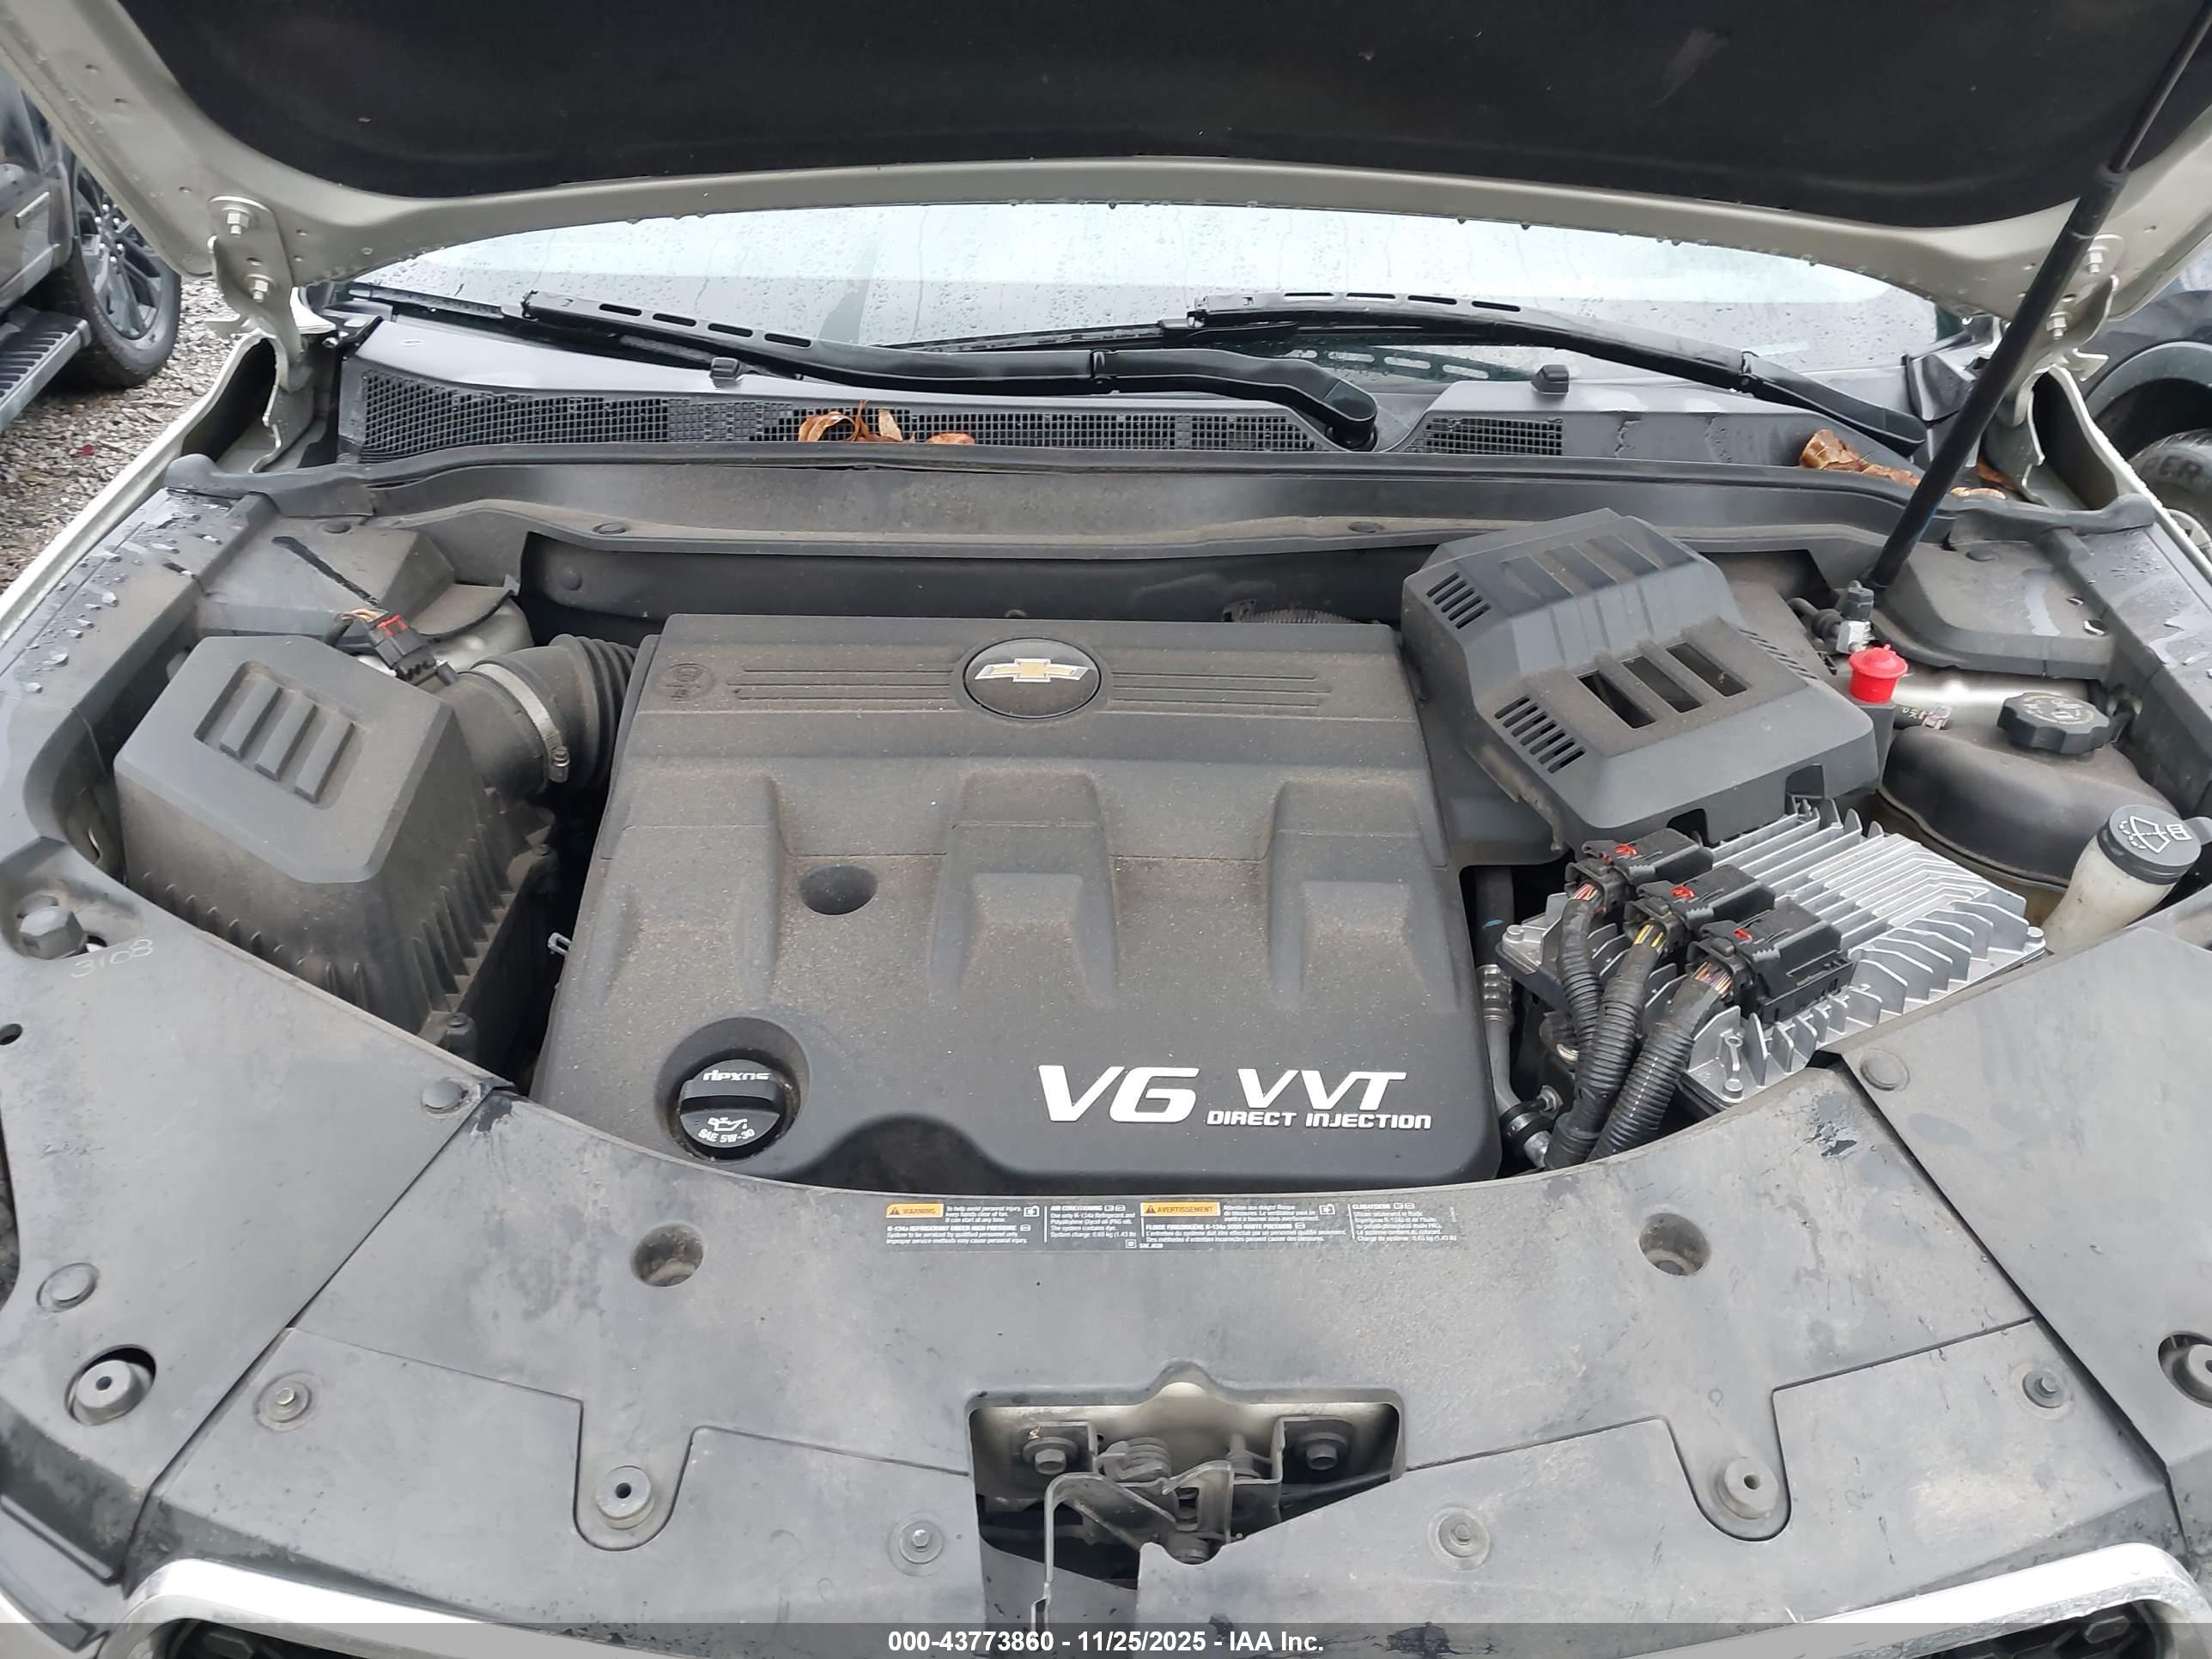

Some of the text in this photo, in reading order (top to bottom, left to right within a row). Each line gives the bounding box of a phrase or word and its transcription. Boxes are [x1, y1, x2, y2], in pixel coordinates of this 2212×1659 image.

[1038, 1065, 1200, 1122] V6
[1237, 1068, 1407, 1110] VVT
[1206, 1110, 1431, 1129] DIRECT INJECTION
